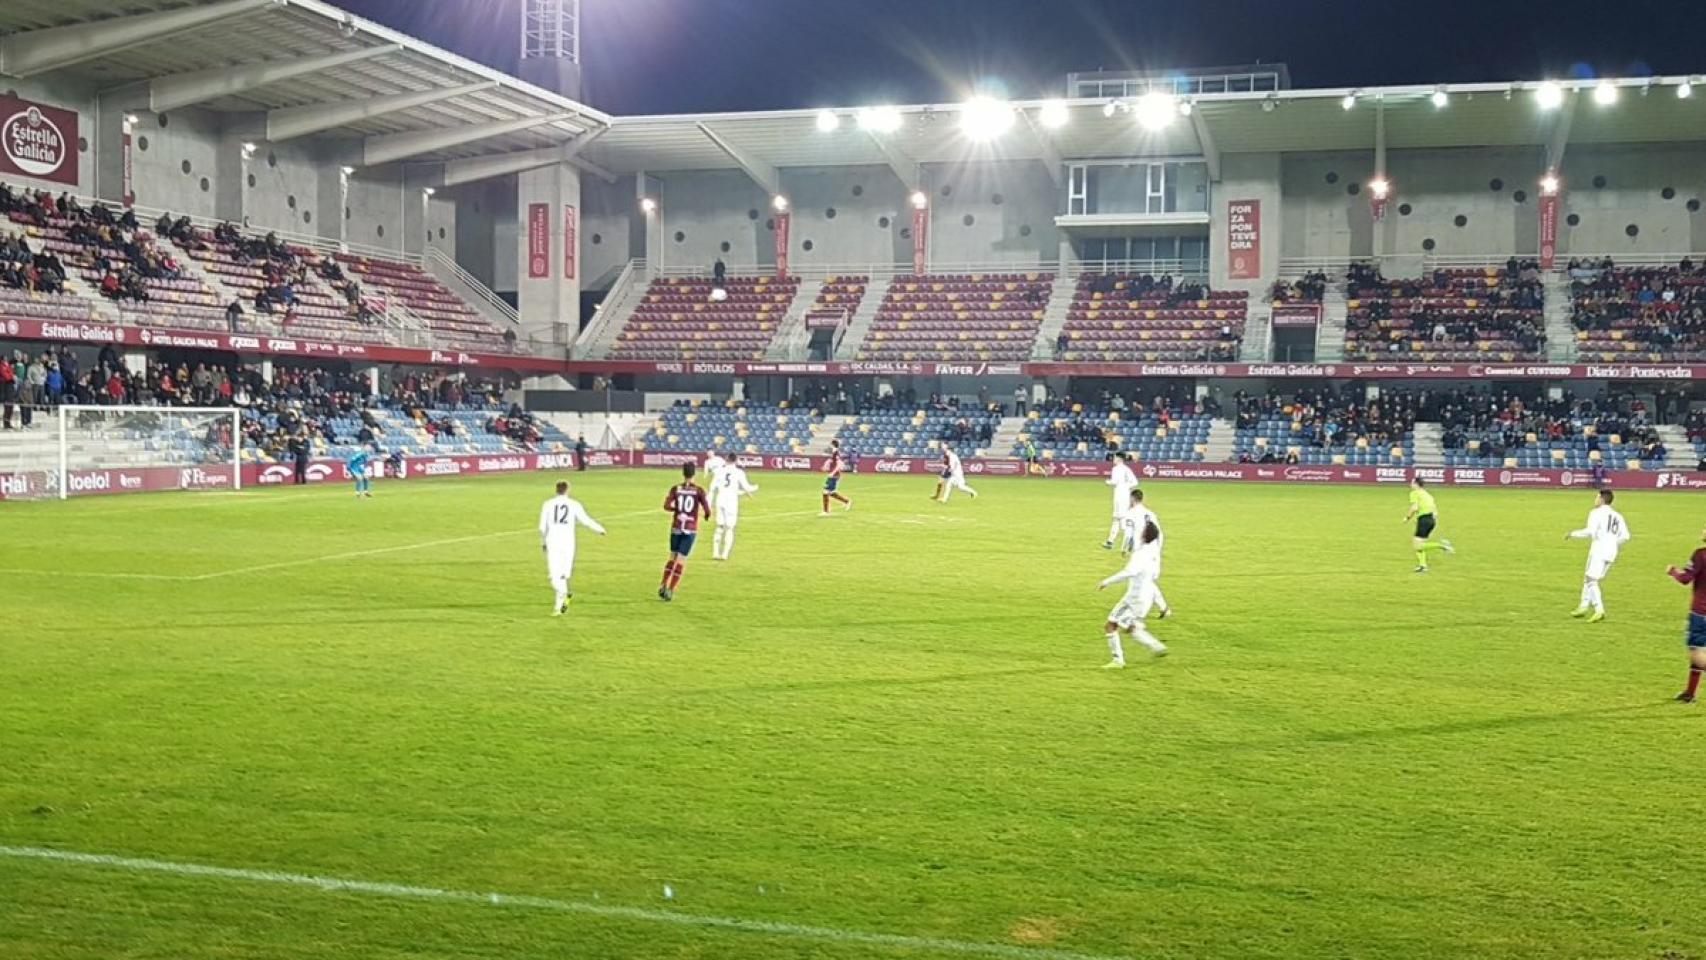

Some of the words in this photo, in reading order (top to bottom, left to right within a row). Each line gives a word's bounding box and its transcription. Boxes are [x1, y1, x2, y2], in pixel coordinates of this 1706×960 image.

[12, 121, 57, 147] Estrella
[14, 139, 55, 162] Galicia
[1230, 205, 1252, 213] FOR
[1231, 214, 1245, 222] ZA
[1230, 223, 1252, 232] PON
[1230, 232, 1257, 240] TEVE
[1230, 241, 1252, 249] DRA
[41, 323, 79, 338] Estrella
[80, 325, 114, 340] Galicia
[152, 335, 171, 345] HOTEL
[173, 336, 196, 346] GALICIA
[935, 364, 973, 374] FAYFER
[1142, 364, 1178, 374] Estrella
[1180, 364, 1214, 374] Galicia
[1248, 365, 1285, 375] Estrella
[1287, 365, 1322, 375] Galicia
[1587, 366, 1619, 378] Diario
[1630, 366, 1692, 378] Pontevedra
[1158, 468, 1182, 477] HOTEL
[1183, 469, 1213, 478] GALICIA
[1214, 470, 1242, 478] PALACE
[1376, 468, 1406, 477] FROIZ
[1415, 469, 1445, 478] FROIZ
[1454, 470, 1484, 478] FROIZ
[1, 475, 27, 493] Hai
[724, 472, 731, 487] 5
[678, 495, 694, 512] 10
[554, 504, 569, 524] 12
